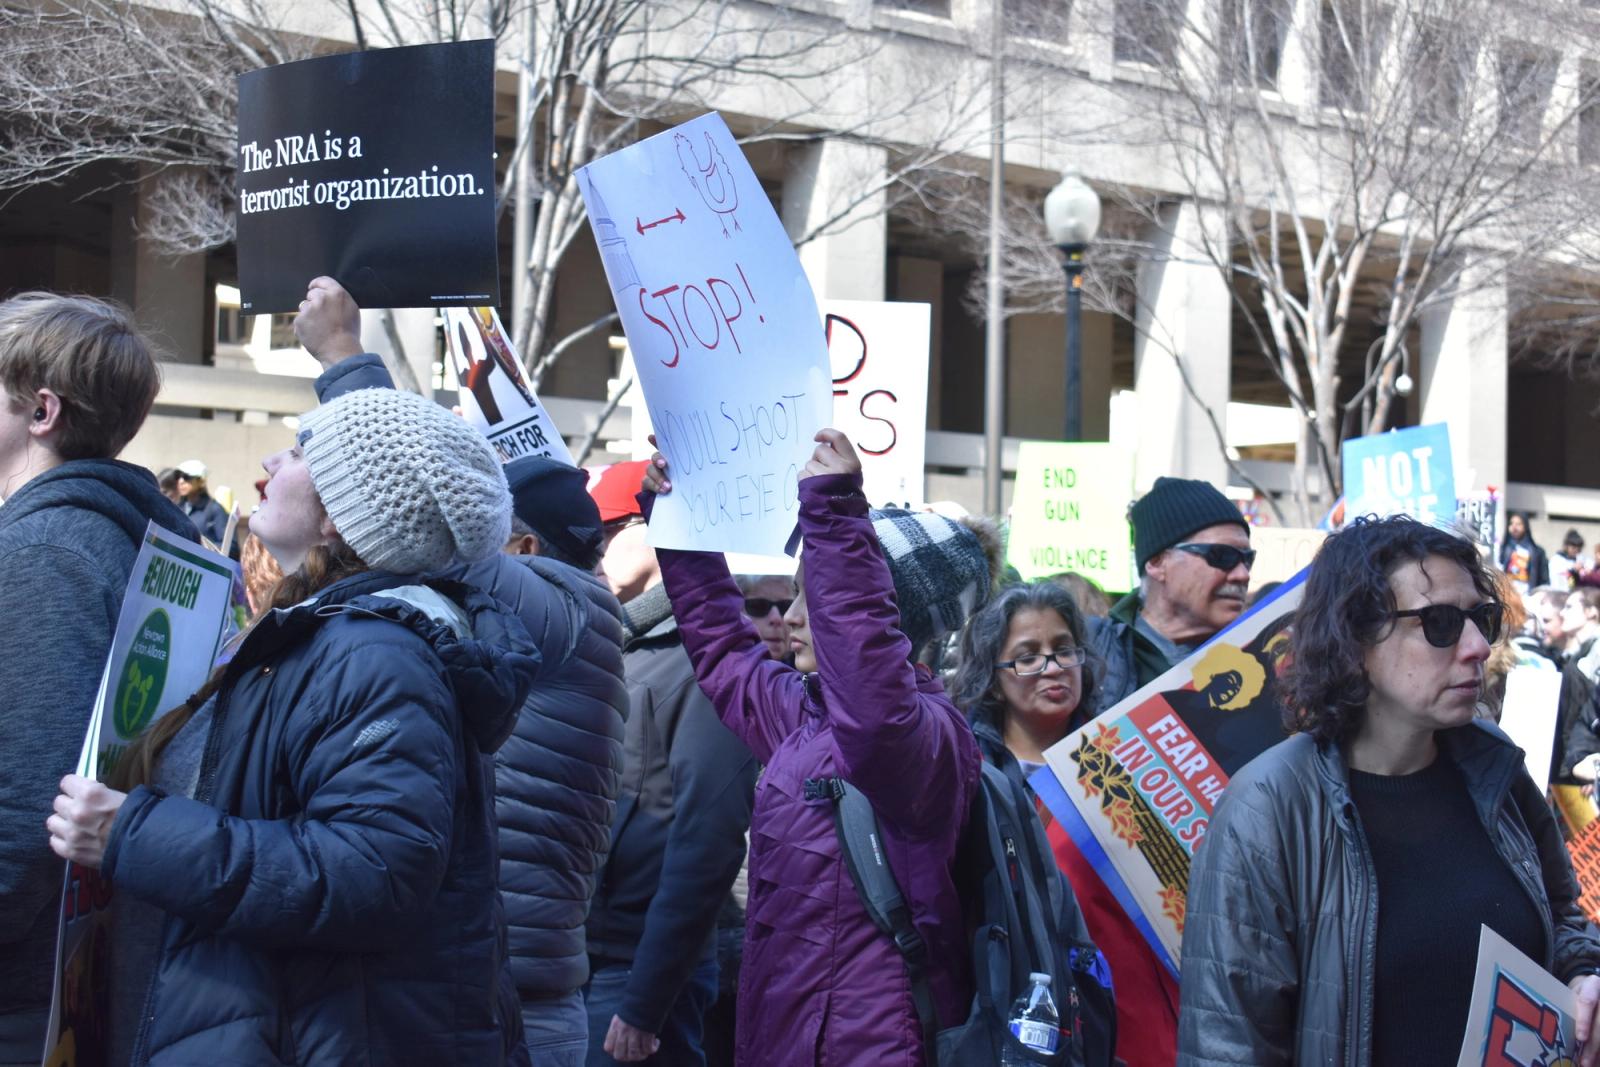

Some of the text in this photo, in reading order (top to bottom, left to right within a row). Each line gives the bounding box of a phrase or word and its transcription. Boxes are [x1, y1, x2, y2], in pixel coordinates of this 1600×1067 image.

[241, 129, 363, 173] The NRA is a
[240, 165, 485, 215] terrorist organization.
[639, 262, 765, 369] STOP!
[516, 423, 550, 453] FOR
[720, 392, 806, 458] SHOOT
[1043, 467, 1077, 489] END
[1362, 446, 1433, 499] NOT
[680, 479, 734, 537] YOUR
[735, 472, 776, 521] EYE
[1044, 500, 1080, 521] GUN
[141, 554, 203, 611] #ENOUGH
[1030, 546, 1108, 570] VIOLENCE
[1146, 713, 1209, 781] FEAR
[1110, 734, 1156, 776] IN
[1138, 766, 1196, 829] OUR
